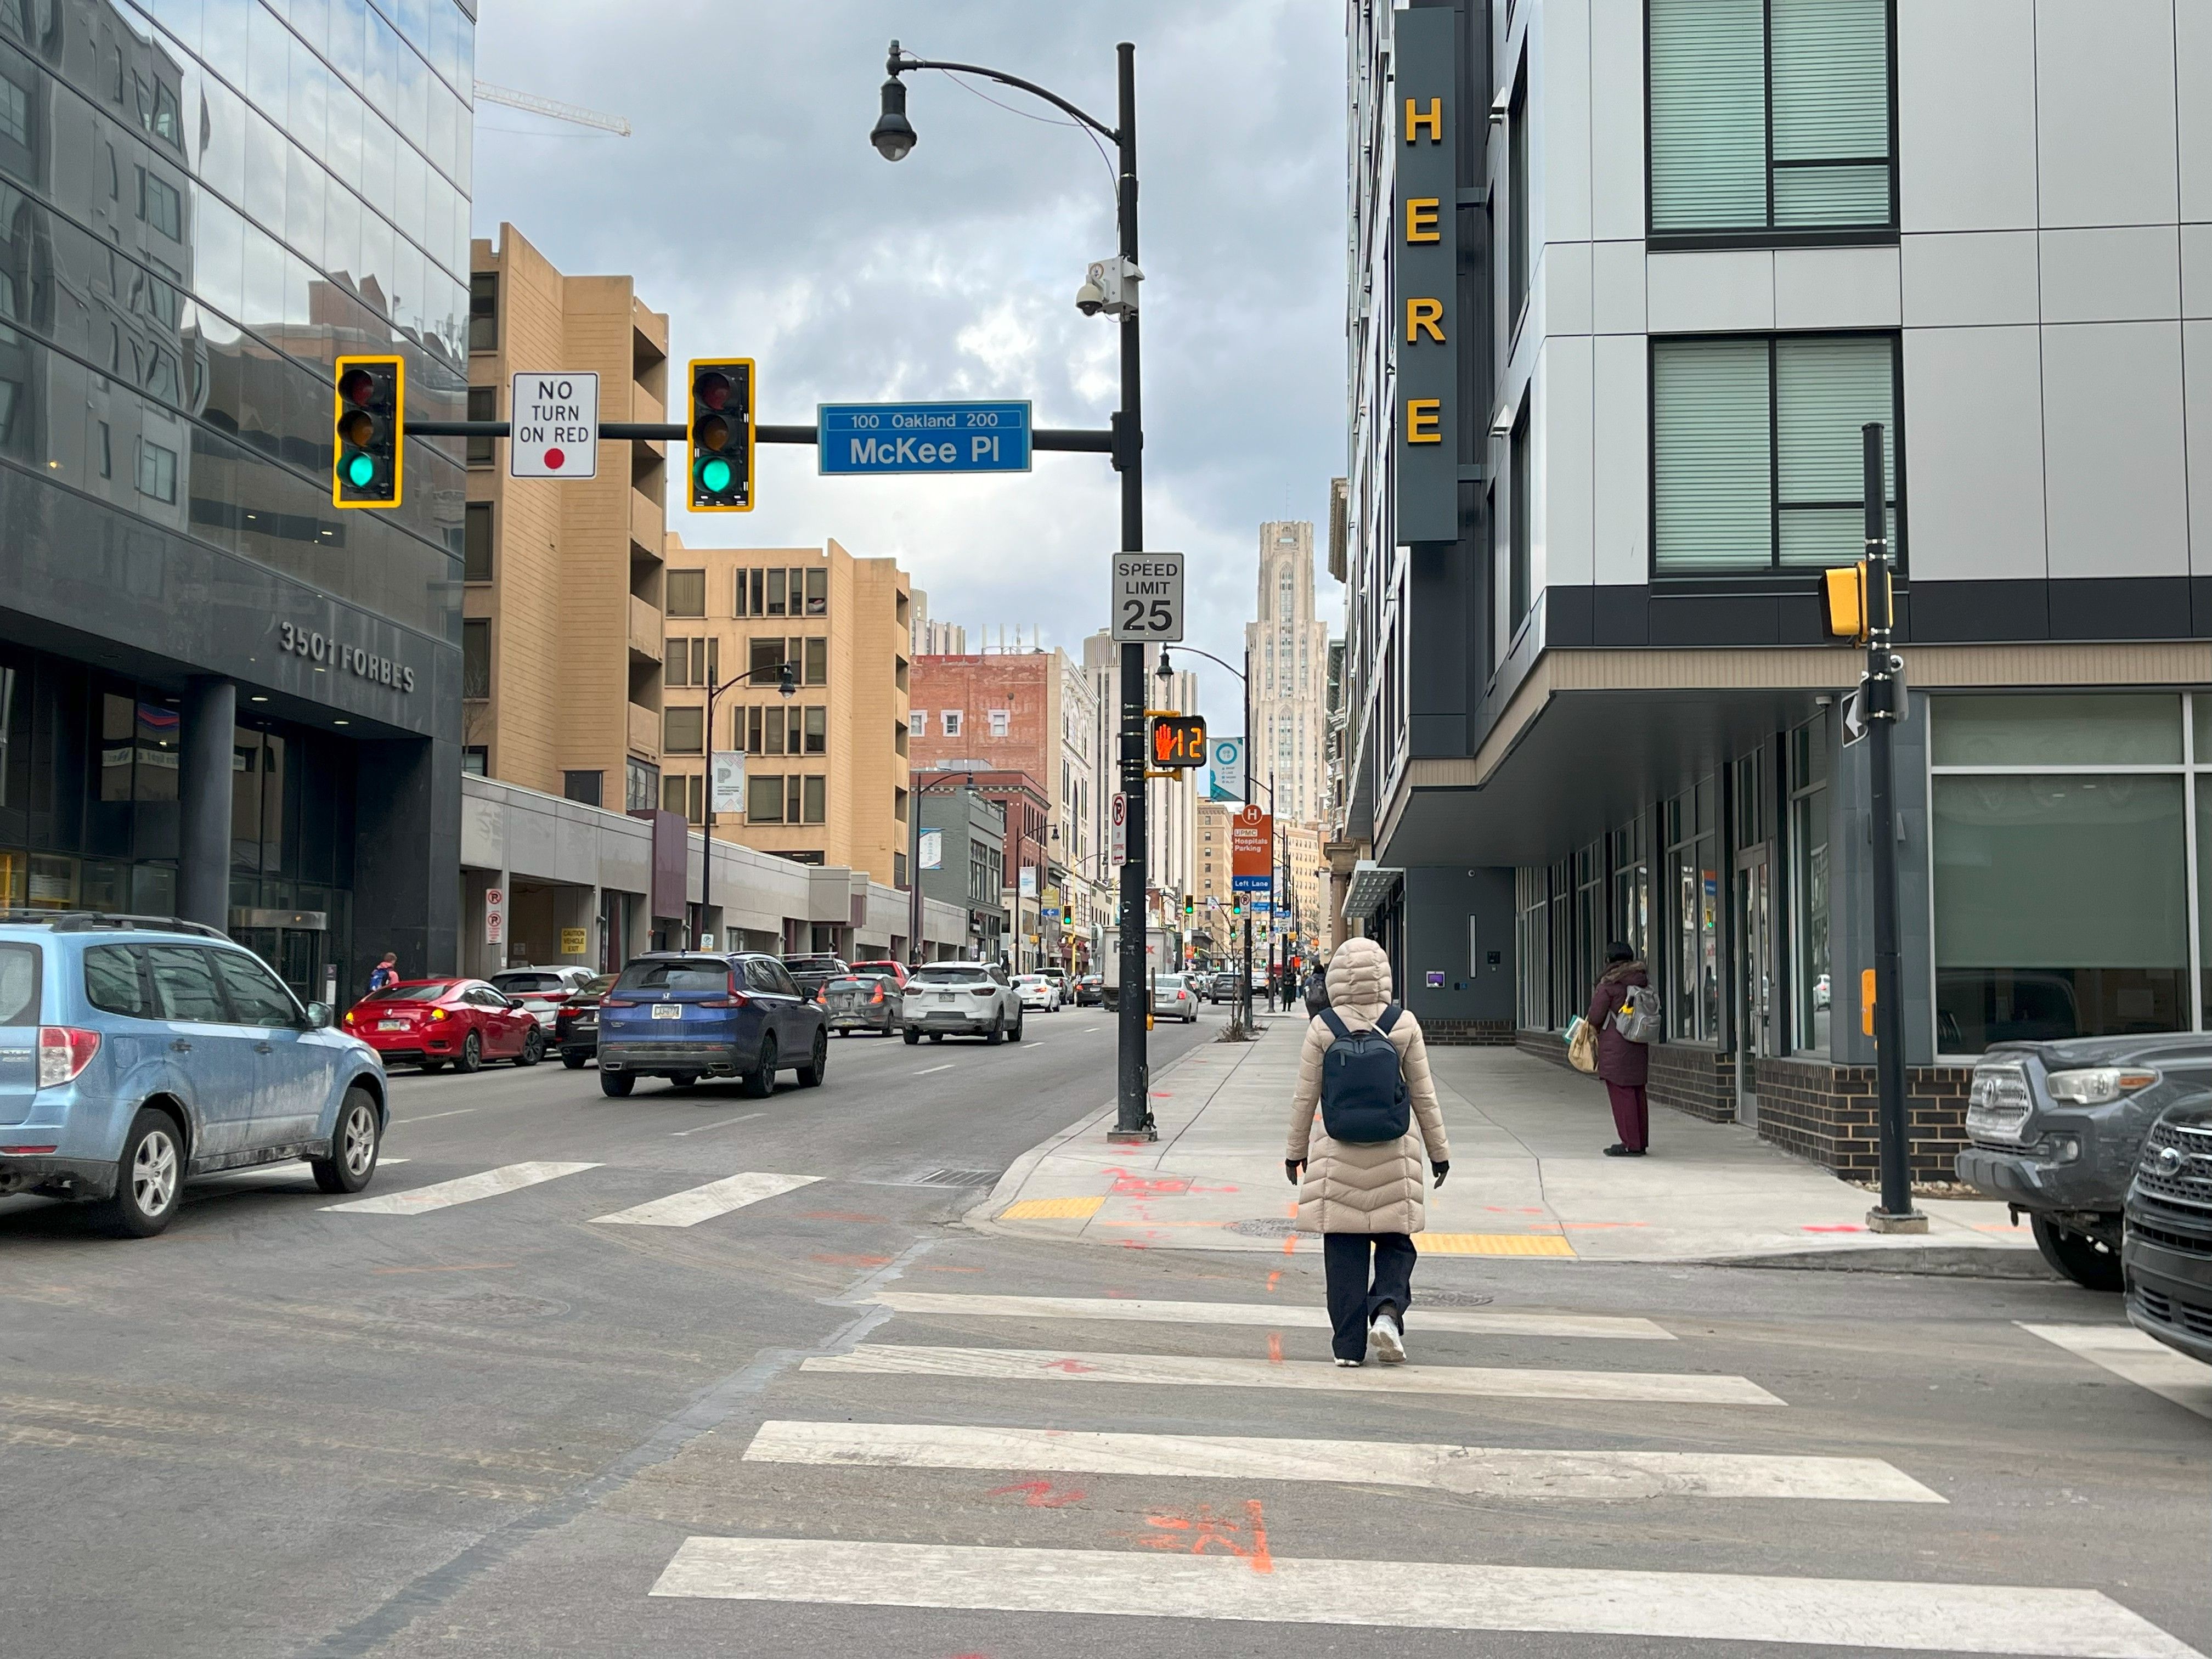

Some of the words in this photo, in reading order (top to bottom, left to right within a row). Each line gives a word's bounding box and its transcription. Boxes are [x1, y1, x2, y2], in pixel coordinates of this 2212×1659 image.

[1406, 97, 1446, 443] HERE
[539, 381, 572, 399] NO
[532, 405, 579, 421] TURN
[851, 415, 879, 428] 100
[891, 414, 956, 428] Oakland
[967, 413, 998, 427] 200
[521, 427, 543, 442] ON
[555, 427, 588, 442] RED
[850, 437, 957, 464] McKee
[972, 436, 998, 462] Pl
[1119, 563, 1178, 576] SPEED
[1126, 582, 1170, 594] LIMIT
[1122, 600, 1172, 631] 25
[281, 621, 334, 665] 3501
[341, 642, 414, 693] FORBES
[1177, 727, 1201, 757] 12
[1247, 809, 1257, 820] H
